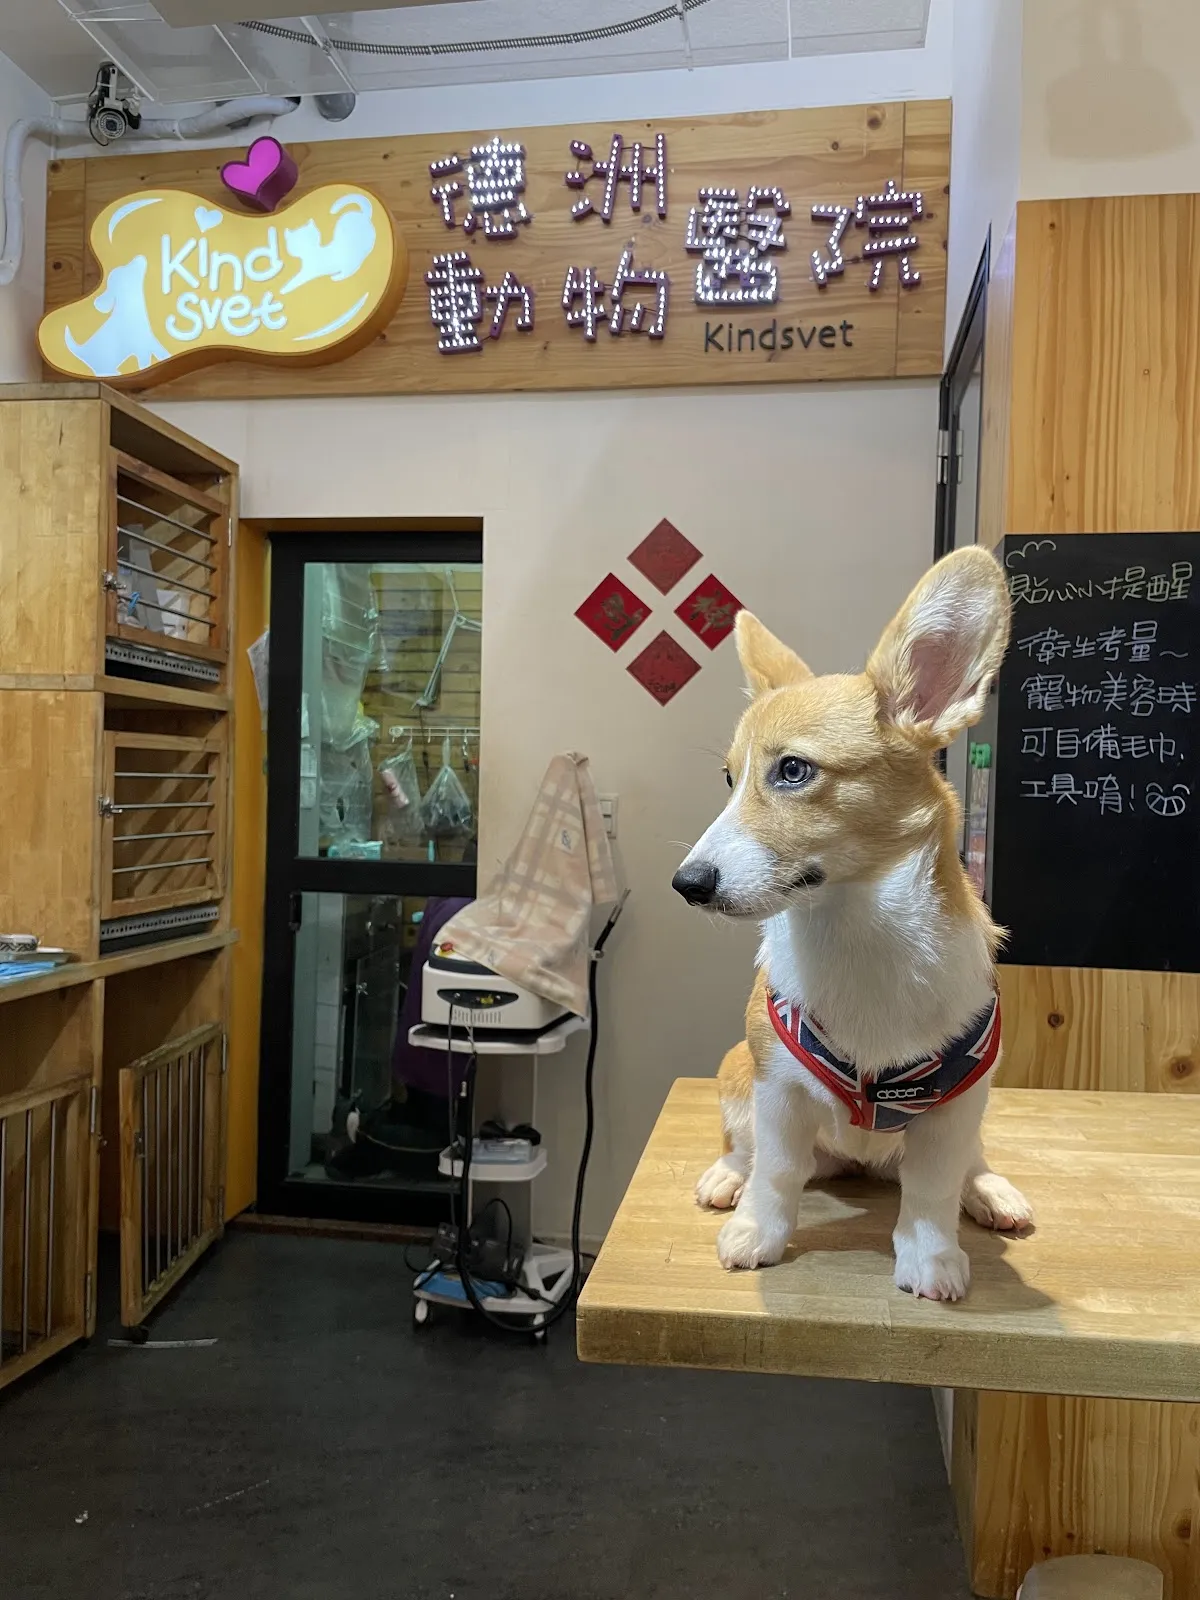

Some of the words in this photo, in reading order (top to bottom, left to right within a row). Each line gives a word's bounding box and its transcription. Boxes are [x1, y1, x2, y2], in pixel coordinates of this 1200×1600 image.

[160, 226, 284, 294] Kind
[684, 180, 924, 306] 醫院
[424, 249, 669, 355] 動物
[704, 318, 853, 353] Kindsvet
[1020, 670, 1198, 717] 寵物美容時
